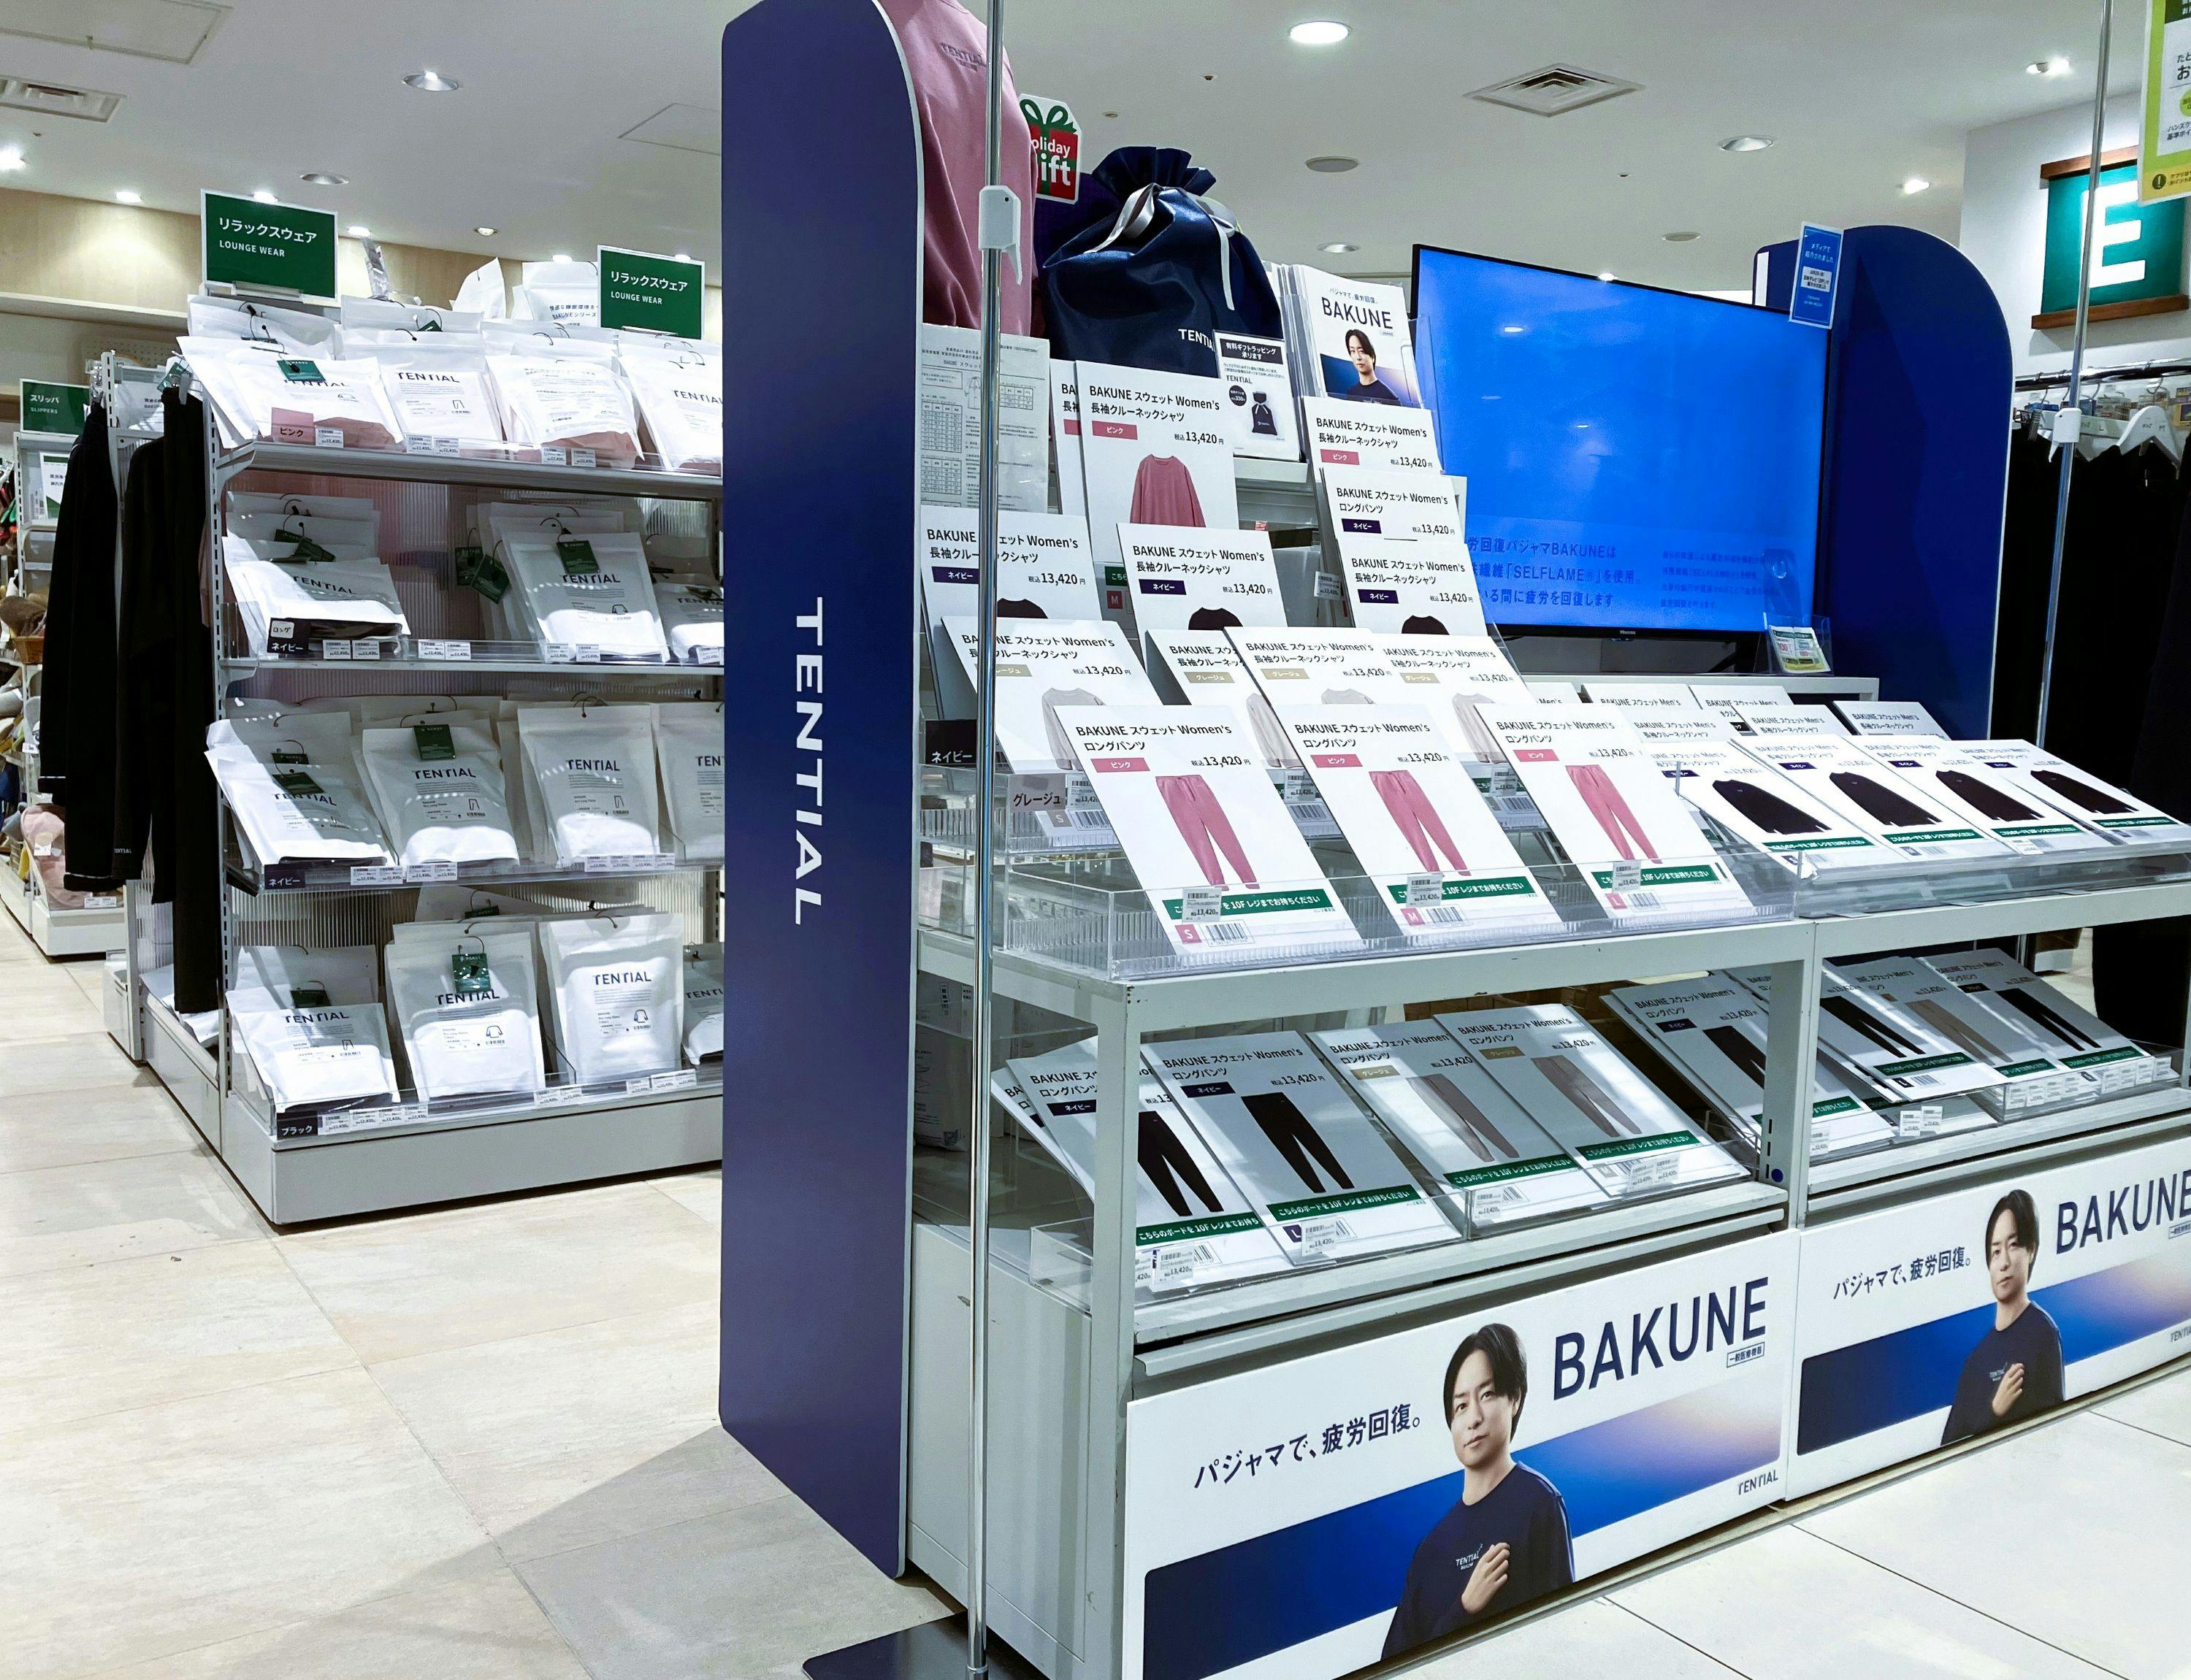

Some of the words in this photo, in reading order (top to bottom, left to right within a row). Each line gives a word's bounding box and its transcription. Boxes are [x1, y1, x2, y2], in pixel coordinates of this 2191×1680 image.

[1031, 136, 1071, 158] oliday
[1041, 153, 1071, 186] ift
[219, 217, 317, 244] リラックスウェア
[2081, 180, 2146, 288] E
[220, 240, 256, 254] LOUNGE
[259, 245, 286, 258] WEAR
[611, 270, 688, 292] リラックスウェア
[611, 291, 639, 302] LOUNGE
[642, 295, 662, 304] WEAR
[1321, 296, 1393, 329] BAKUNE
[1178, 328, 1214, 351] TENTIA
[1226, 342, 1276, 355] 有料ギフトラッピング
[1242, 352, 1262, 360] 承ります
[398, 372, 460, 383] TENTIAL
[1226, 375, 1253, 384] TENTIAL
[30, 395, 60, 404] スリッパ
[1090, 385, 1132, 400] BAKUNE
[1134, 390, 1173, 404] スウェット
[1175, 395, 1220, 410] Women's
[1091, 402, 1185, 422] 長袖クルーネックシャツ
[280, 427, 304, 437] ピンク
[1106, 426, 1124, 434] ピンク
[1316, 418, 1353, 430] BAKUNE
[1354, 422, 1388, 433] スウェット
[1389, 425, 1427, 437] Women's
[1318, 433, 1399, 448] 長袖クルーネックシャツ
[1337, 488, 1374, 499] BAKUNE
[1375, 491, 1408, 502] スウェット
[1410, 493, 1448, 505] Women's
[1339, 504, 1383, 513] ロングパンツ
[927, 529, 976, 542] BAKUNE
[1027, 534, 1079, 548] Women's
[1133, 545, 1177, 557] BAKUNE
[1178, 548, 1218, 559] スウェット
[1220, 549, 1265, 561] Women's
[1468, 537, 1616, 558] 労回復パジャマBAKUNEは
[1136, 561, 1231, 575] 長袖クルーネックシャツ
[1351, 558, 1389, 569] BAKUNE
[1390, 560, 1425, 570] スウェット
[1426, 562, 1465, 572] Women's
[562, 575, 620, 583] TENTIAL
[948, 572, 974, 580] ネイビー
[1355, 573, 1437, 585] 長袖クルーネックシャツ
[293, 576, 358, 594] TENTIAL
[272, 643, 303, 651] ネイビー
[1014, 636, 1060, 645] スウェット
[1062, 637, 1115, 647] Women's
[1246, 643, 1290, 652] BAKUNE
[1291, 643, 1328, 652] スウェット
[1328, 643, 1374, 652] Women's
[1169, 645, 1214, 655] BAKUNE
[1420, 648, 1455, 657] スウェット
[1456, 648, 1496, 658] Women's
[1075, 726, 1128, 736] BAKUNE
[1130, 726, 1175, 736] スウェット
[1177, 724, 1232, 735] Women's
[1295, 724, 1339, 734] BAKUNE
[1342, 724, 1382, 733] スウェット
[1383, 724, 1430, 732] Women's
[1496, 721, 1537, 730] BAKUNE
[1537, 721, 1572, 730] スウェット
[1572, 721, 1615, 729] Women's
[1084, 741, 1146, 751] ロングパンツ
[1303, 739, 1356, 748] ロングパンツ
[795, 597, 822, 925] TENTIAL
[931, 751, 973, 763] ネイビー
[568, 759, 620, 771] TENTIAL
[415, 768, 476, 779] TENTIAL
[1012, 791, 1060, 808] グレージュ
[1055, 815, 1063, 824] S
[269, 878, 300, 886] ネイビー
[1231, 900, 1245, 909] 10F
[1247, 895, 1320, 907] レジまでお持ちください
[1613, 897, 1622, 906] L
[1408, 913, 1418, 922] M
[1184, 929, 1193, 939] S
[594, 971, 651, 985] TENTIAL
[437, 989, 500, 1005] TENTIAL
[685, 989, 723, 999] TENTI
[286, 1012, 349, 1023] TENTIAL
[1458, 1025, 1496, 1035] BAKUNE
[1496, 1021, 1532, 1032] スウェット
[1532, 1018, 1572, 1028] Women's
[1330, 1042, 1373, 1054] BAKUNE
[1373, 1038, 1412, 1048] スウェット
[1163, 1056, 1210, 1068] BAKUNE
[1209, 1054, 1253, 1065] スウェット
[1253, 1048, 1303, 1059] Women's
[1341, 1052, 1391, 1065] ロングパンツ
[1030, 1073, 1082, 1084] BAKUNE
[1172, 1067, 1228, 1080] ロングパンツ
[282, 1125, 313, 1135] ブラック
[1277, 1202, 1327, 1216] こちらのボードを
[2055, 1170, 2191, 1255] BAKUNE
[1139, 1226, 1193, 1241] こちらのボードを
[1196, 1224, 1210, 1233] 10F
[1832, 1245, 1972, 1301] パジャマで、疲労回復。
[1553, 1276, 1770, 1401] BAKUNE
[2169, 1325, 2191, 1344] TENTIA
[1193, 1400, 1422, 1492] パジャマで、疲労回復。
[1737, 1468, 1779, 1498] TENTIAL
